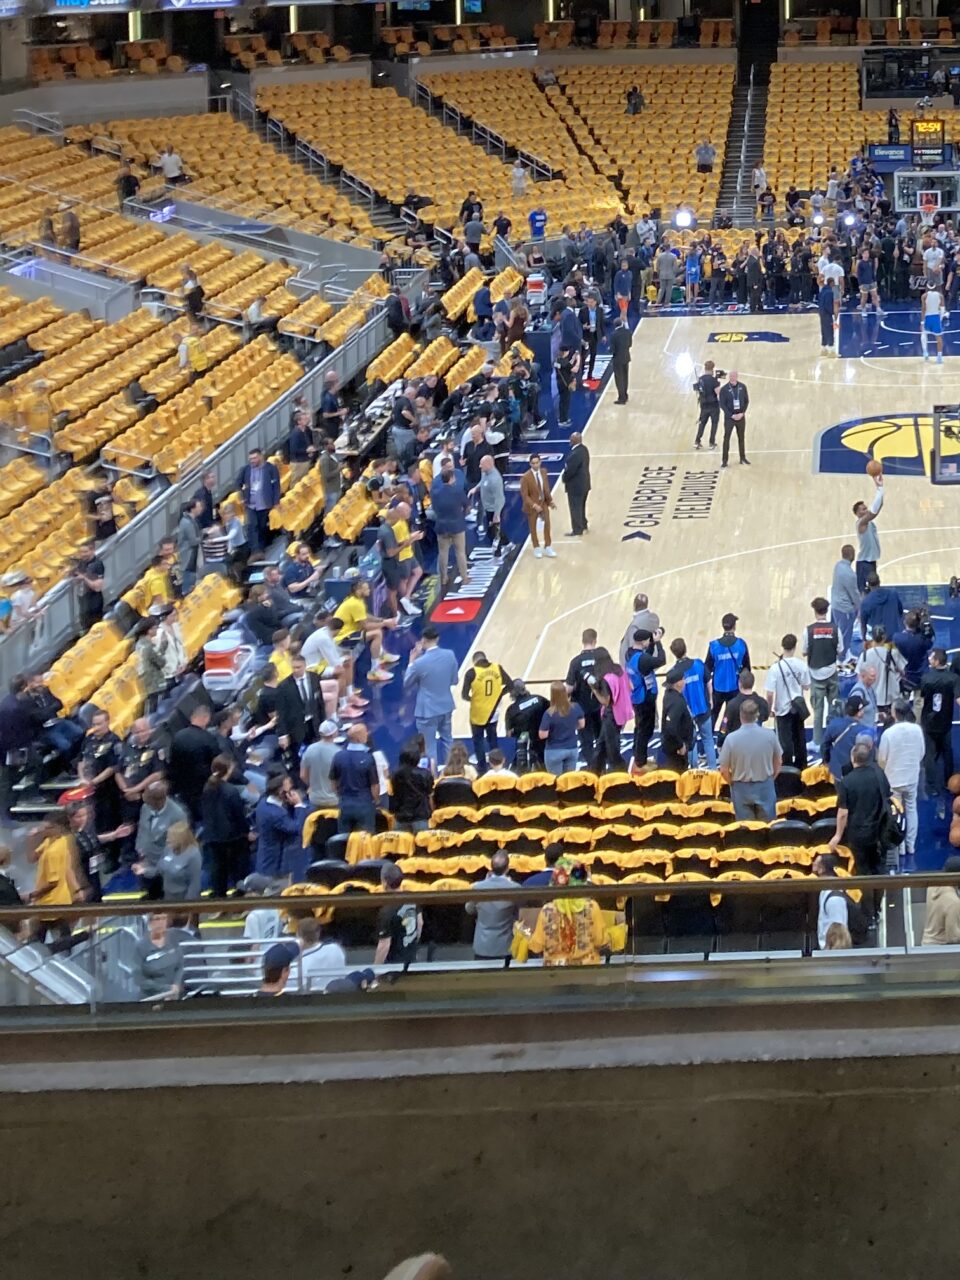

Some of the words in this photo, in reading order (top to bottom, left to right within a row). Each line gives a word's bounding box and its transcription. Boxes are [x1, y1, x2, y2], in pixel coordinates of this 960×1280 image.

[624, 466, 677, 528] GAINBRIDGE
[672, 470, 719, 519] FIELDHOUSE
[484, 679, 493, 697] 0
